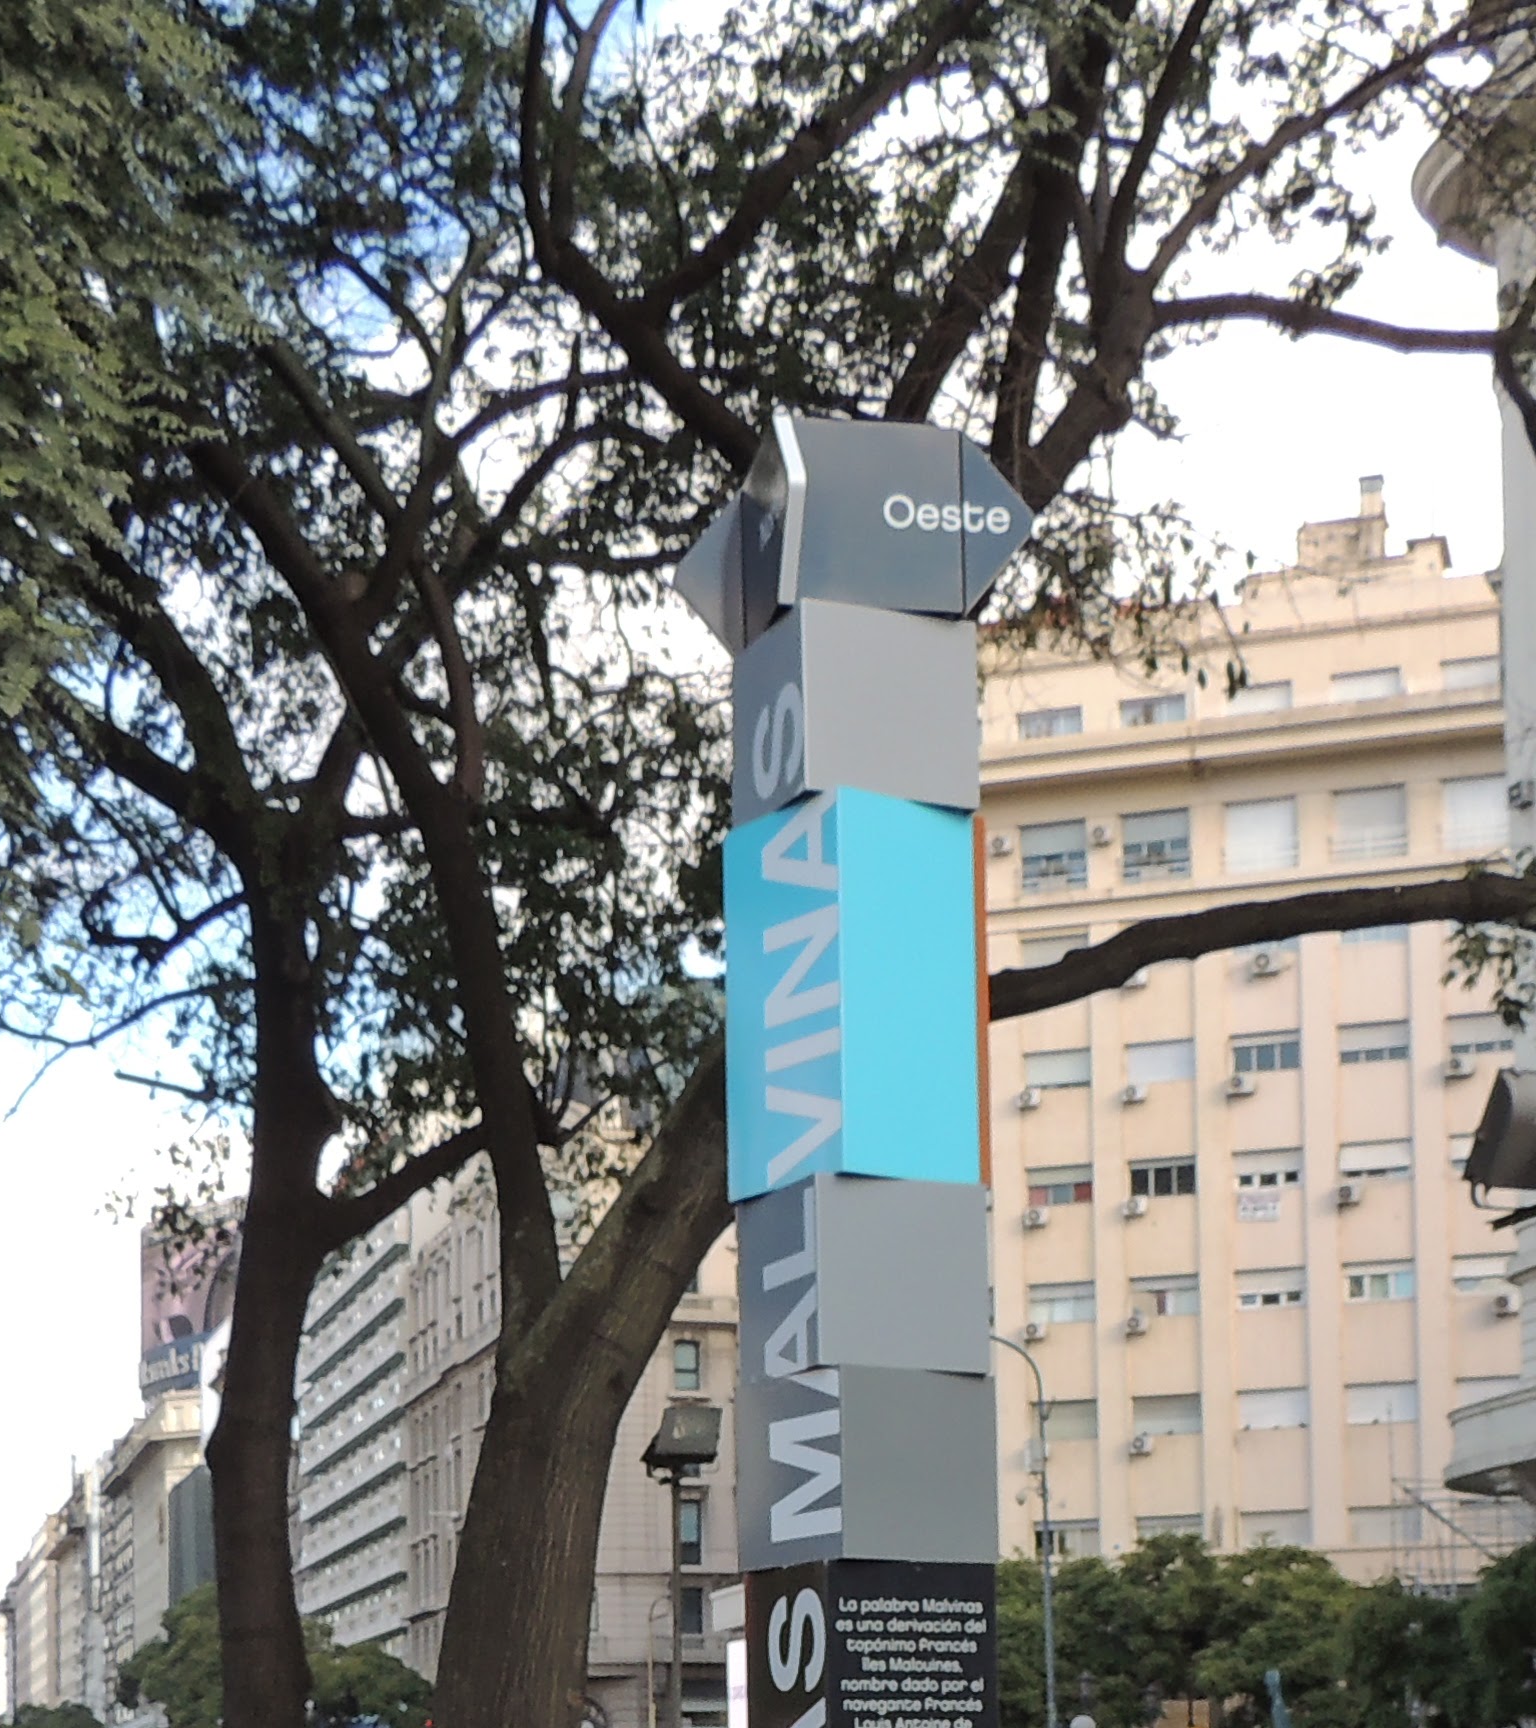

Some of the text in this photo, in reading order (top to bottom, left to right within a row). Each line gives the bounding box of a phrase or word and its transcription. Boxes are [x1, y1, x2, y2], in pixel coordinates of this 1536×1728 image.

[883, 493, 1012, 535] Oeste
[752, 682, 843, 1545] MALVINAS
[839, 1597, 983, 1615] La palabra Malvinas
[835, 1616, 987, 1633] es una derivación del
[846, 1637, 916, 1654] topónimo
[840, 1676, 985, 1695] nombre dado por el
[843, 1699, 922, 1715] navegante
